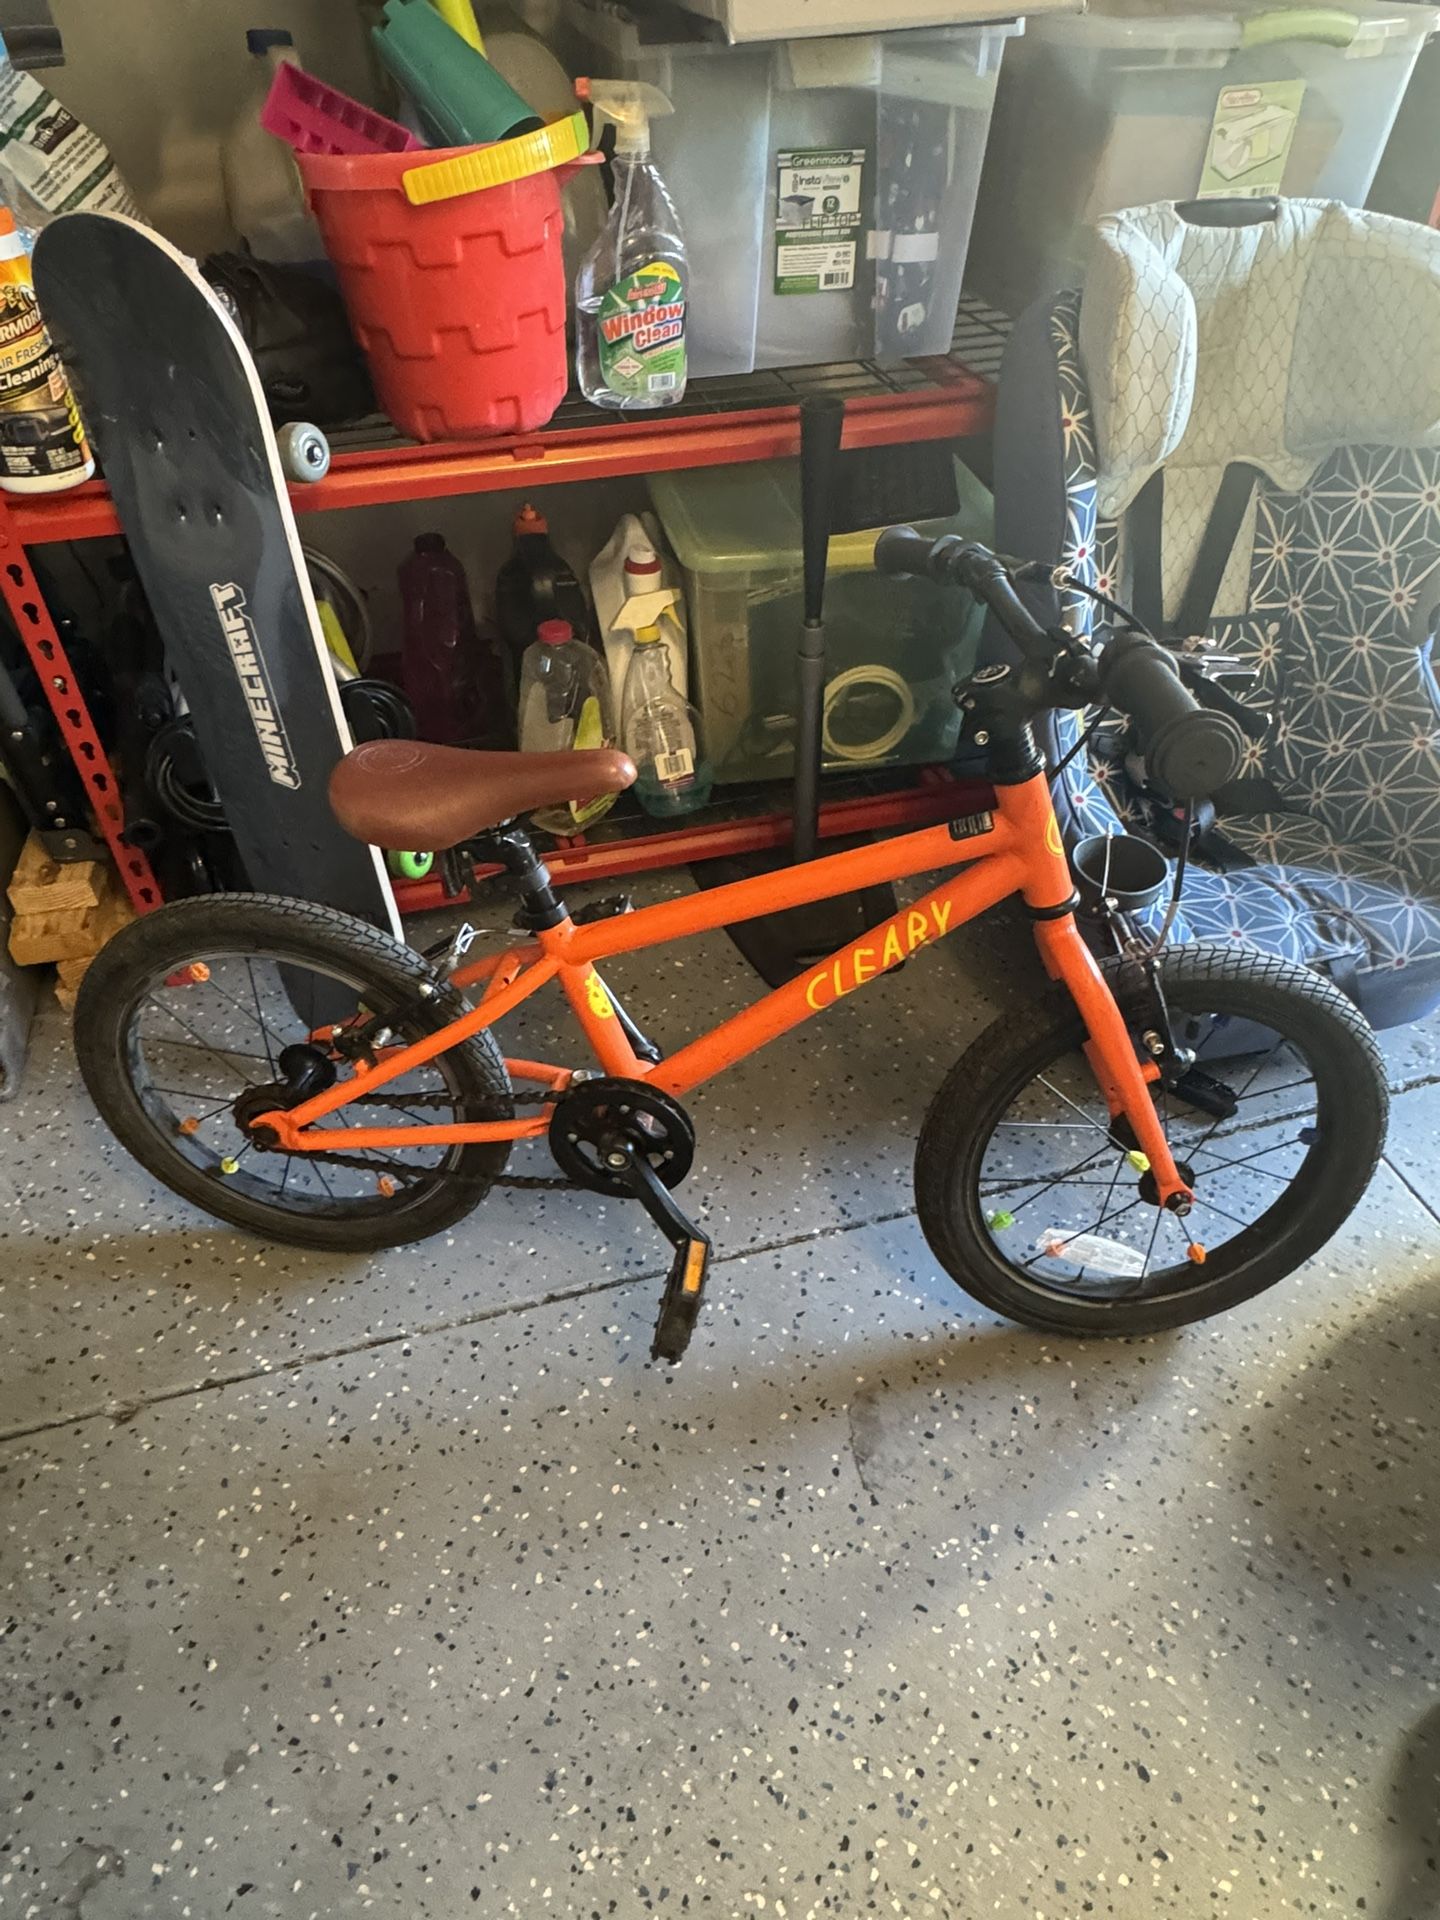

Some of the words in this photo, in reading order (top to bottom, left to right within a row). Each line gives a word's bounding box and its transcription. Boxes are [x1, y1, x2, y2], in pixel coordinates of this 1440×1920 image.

[0, 309, 39, 343] RMOR
[603, 303, 684, 342] Window
[635, 323, 680, 348] Clean
[0, 356, 14, 370] IR
[210, 584, 301, 789] MINECRAFT
[806, 900, 952, 1010] CLEARY
